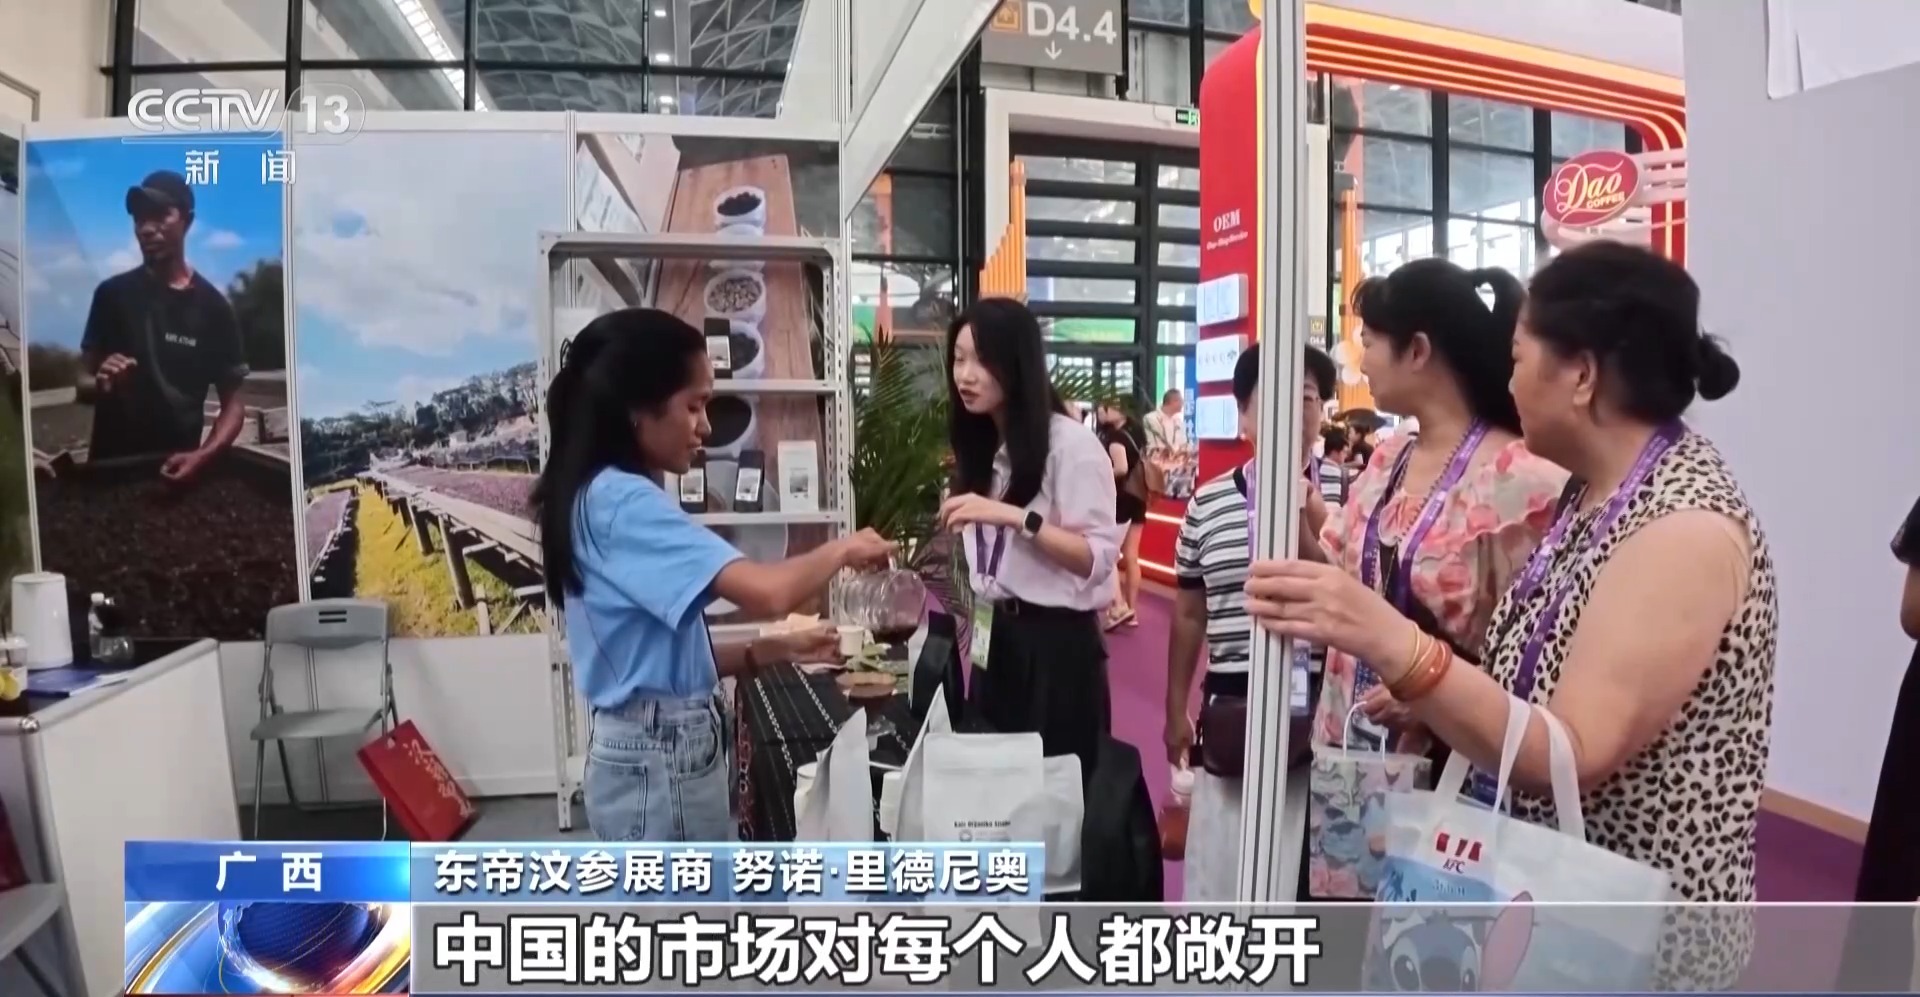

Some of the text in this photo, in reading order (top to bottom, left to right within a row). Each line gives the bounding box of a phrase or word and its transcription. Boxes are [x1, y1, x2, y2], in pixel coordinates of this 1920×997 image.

[1026, 1, 1118, 45] D4.4
[1555, 162, 1623, 214] Dao
[1586, 191, 1626, 209] COFFEE
[1213, 208, 1241, 233] OEM
[1443, 858, 1465, 874] KFC
